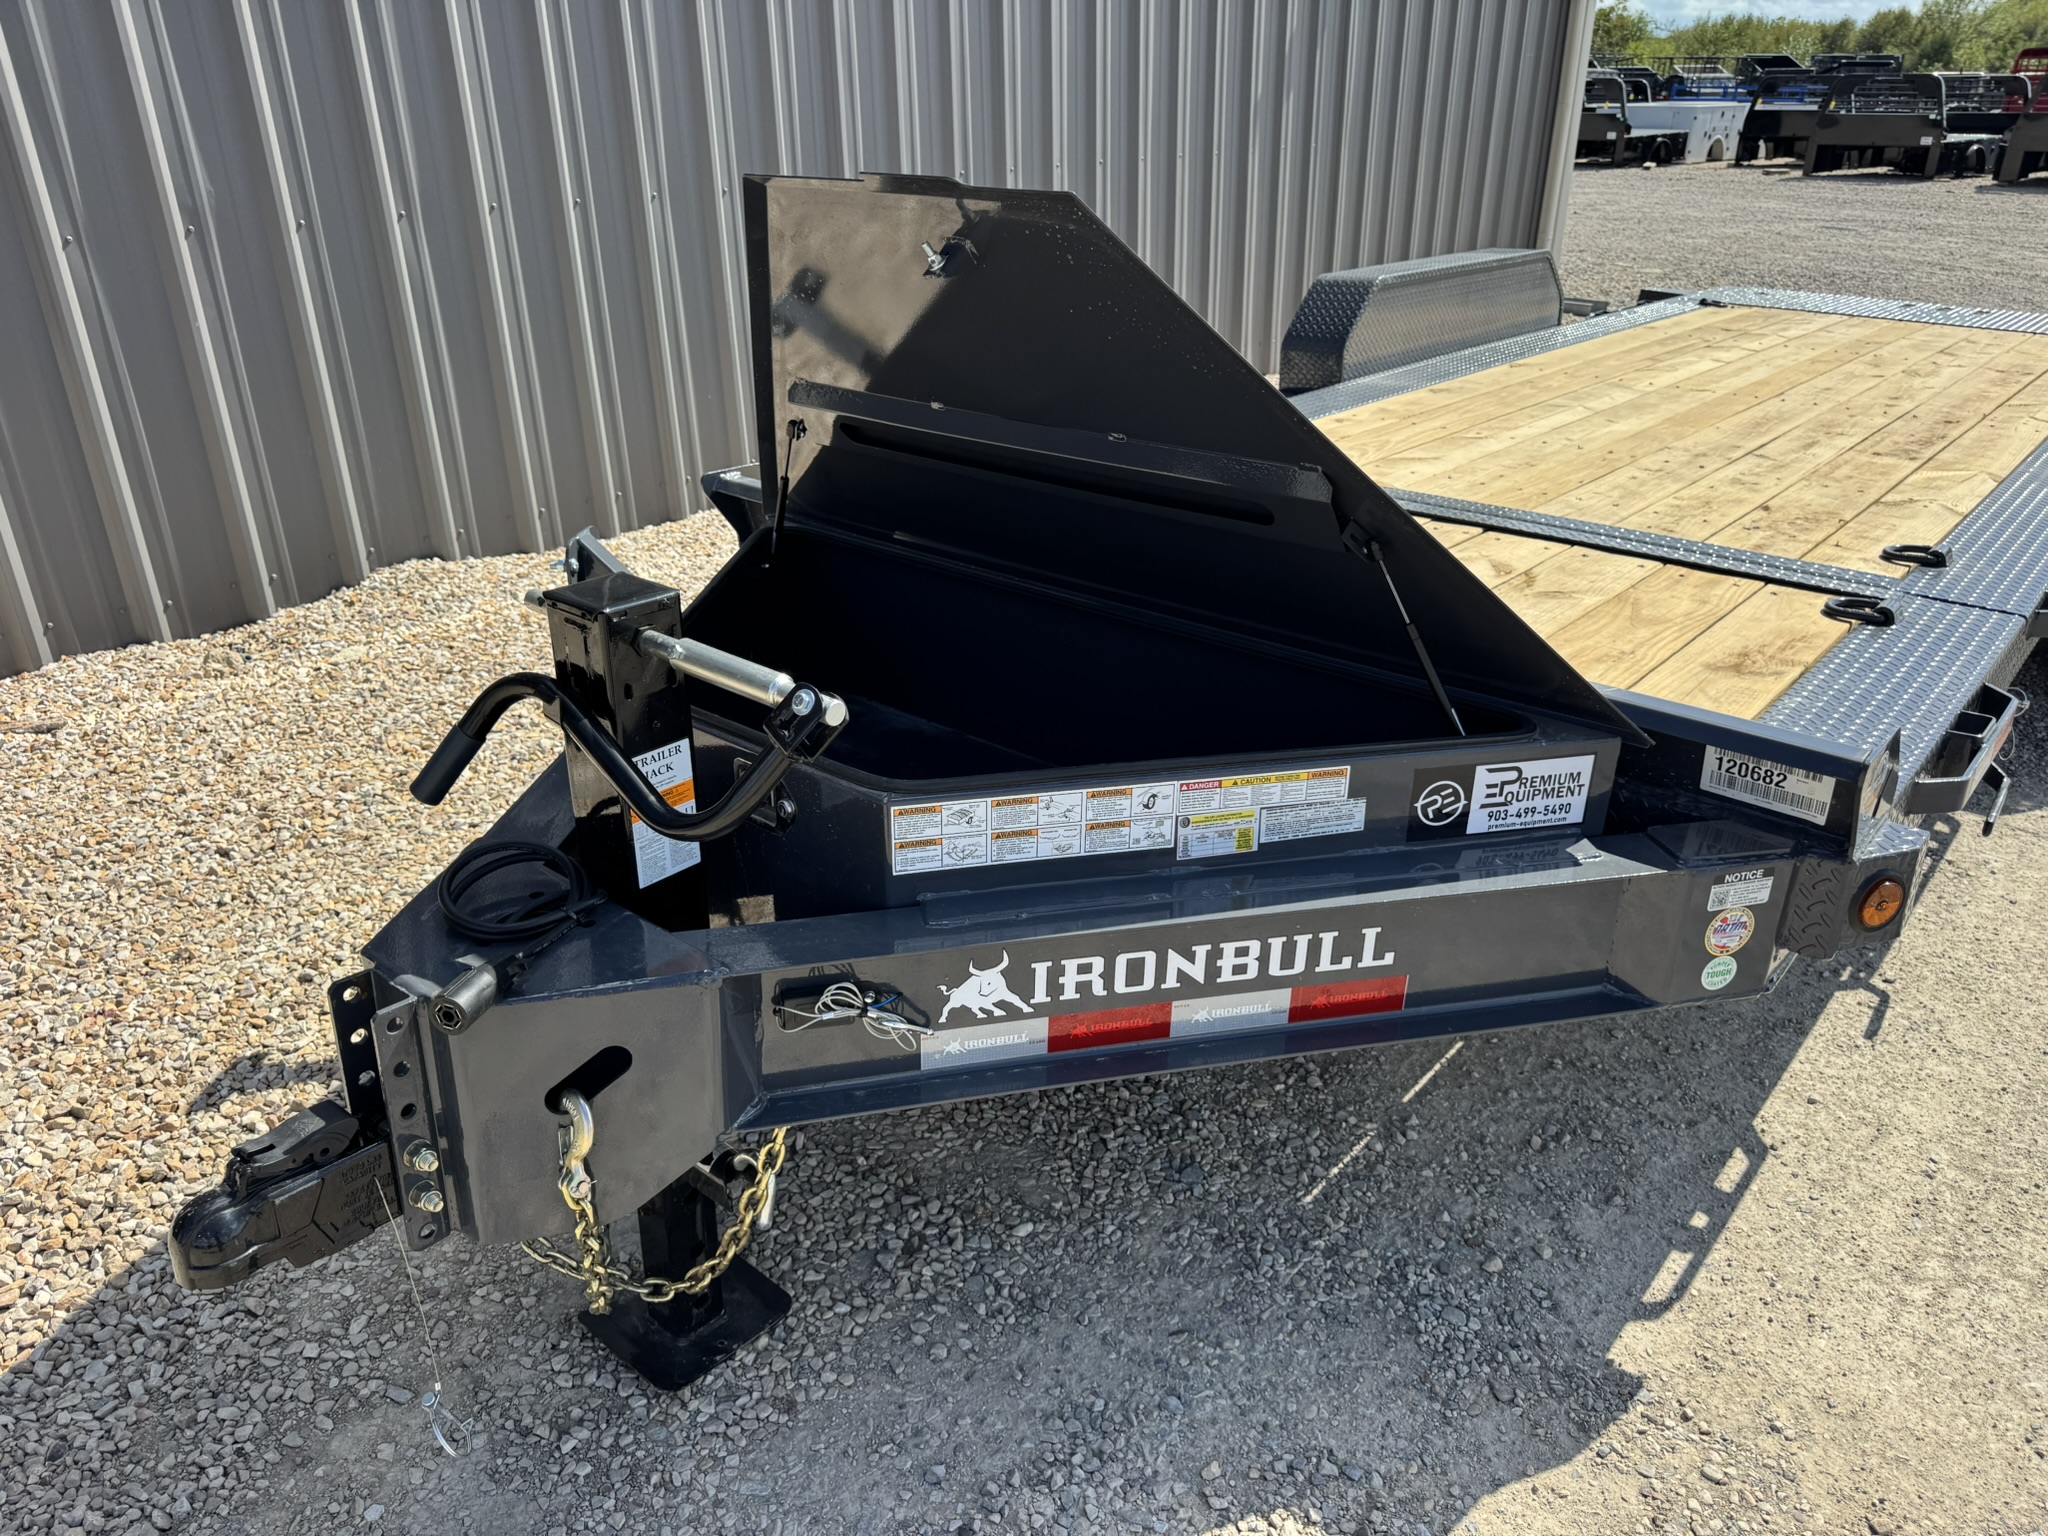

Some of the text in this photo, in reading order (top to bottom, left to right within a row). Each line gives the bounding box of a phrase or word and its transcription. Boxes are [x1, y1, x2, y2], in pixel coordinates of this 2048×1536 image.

[634, 744, 682, 768] TRAILER
[645, 761, 674, 779] JACK
[1311, 769, 1345, 779] WARNING
[1714, 756, 1788, 789] 120682
[1188, 781, 1220, 790] DANGER
[1240, 776, 1272, 786] CAUTION
[1485, 765, 1582, 798] PREMIUM
[1096, 788, 1127, 798] WARNING
[1478, 783, 1585, 810] EQUIPMENT
[1000, 797, 1033, 807] WARNING
[903, 806, 936, 816] WARNING
[1487, 802, 1572, 823] 903-499-5490
[1094, 820, 1126, 830] WARNING
[1487, 816, 1567, 831] premium-equipment.com
[1000, 829, 1033, 839] WARNING
[903, 839, 937, 849] WARNING
[1724, 869, 1765, 884] NOTICE
[1030, 926, 1395, 1005] IRONBULL
[1705, 967, 1732, 980] TOUGH
[1328, 989, 1388, 1004] IRONBULL
[1211, 1001, 1272, 1019] IRONBULL
[1090, 1017, 1153, 1032] IRONBULL
[963, 1031, 1030, 1050] IRONBULL
